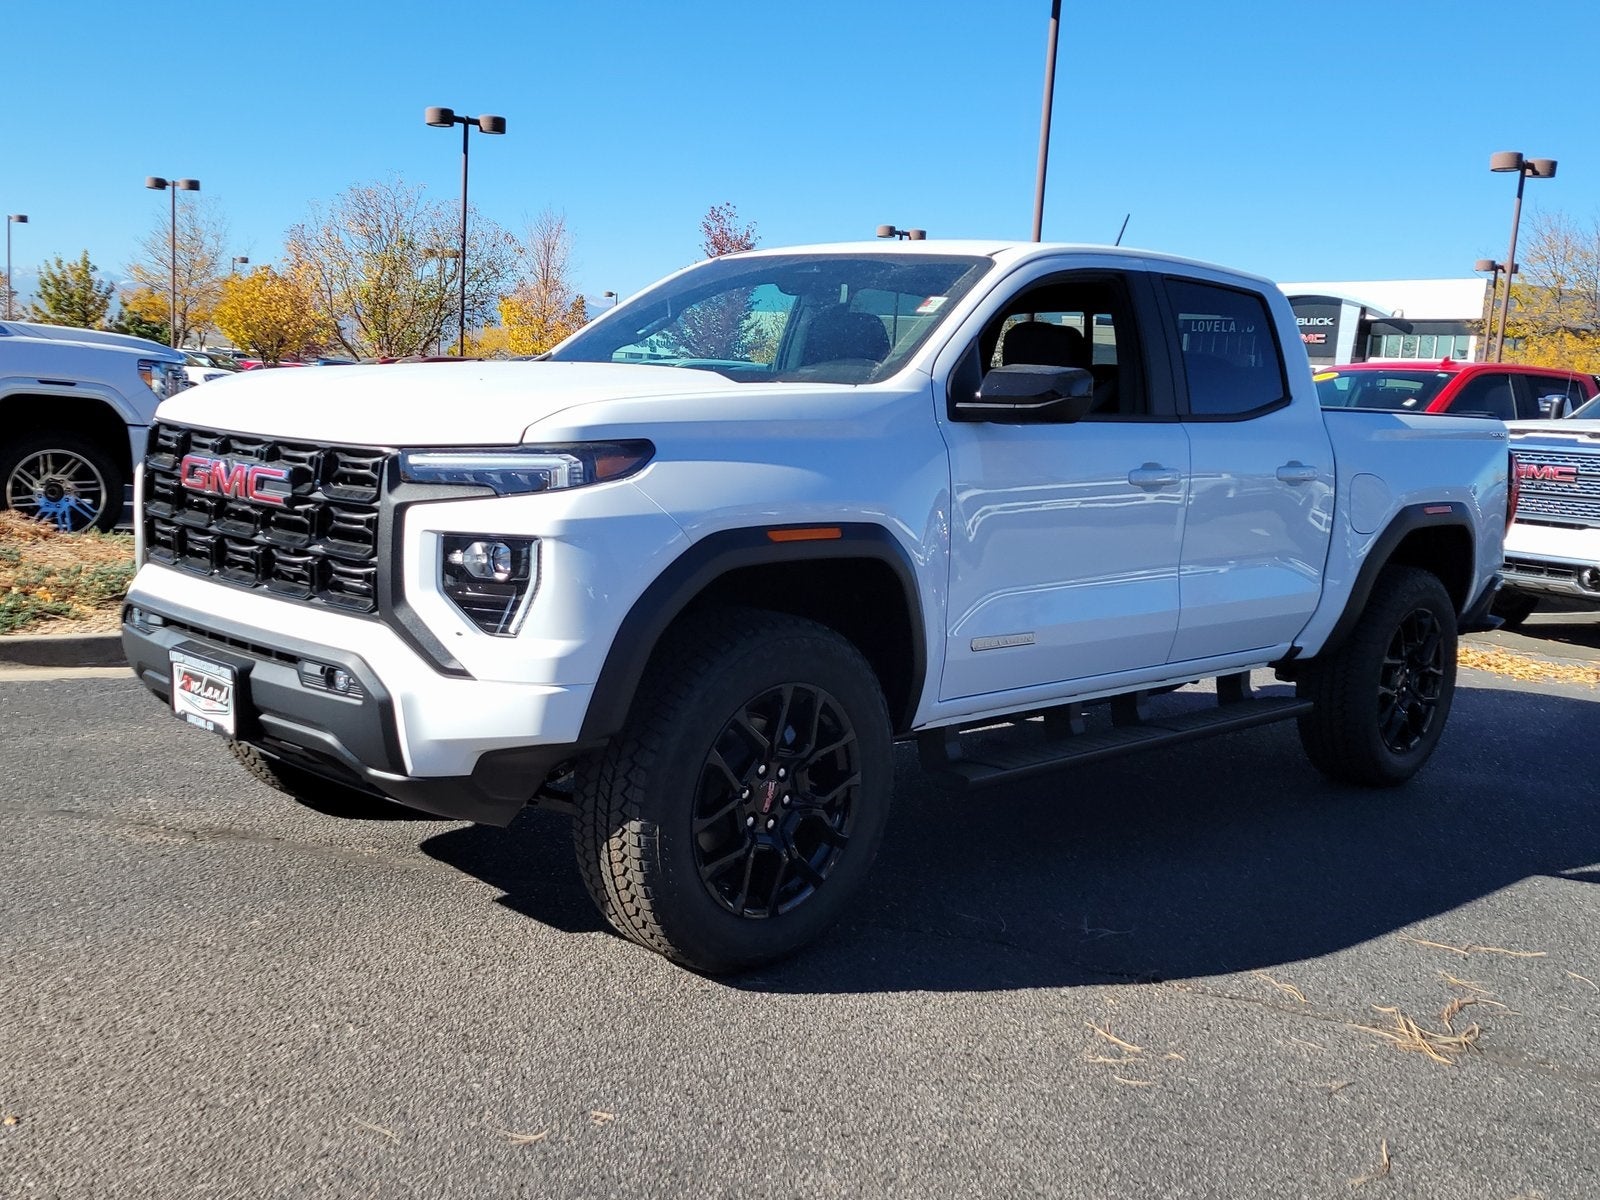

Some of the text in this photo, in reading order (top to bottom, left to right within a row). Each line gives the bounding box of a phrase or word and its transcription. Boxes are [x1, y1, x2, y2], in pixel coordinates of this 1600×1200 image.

[1191, 320, 1255, 333] LOVELAD
[1296, 317, 1334, 326] BUICK
[1300, 333, 1326, 343] MC
[181, 455, 290, 504] GMC
